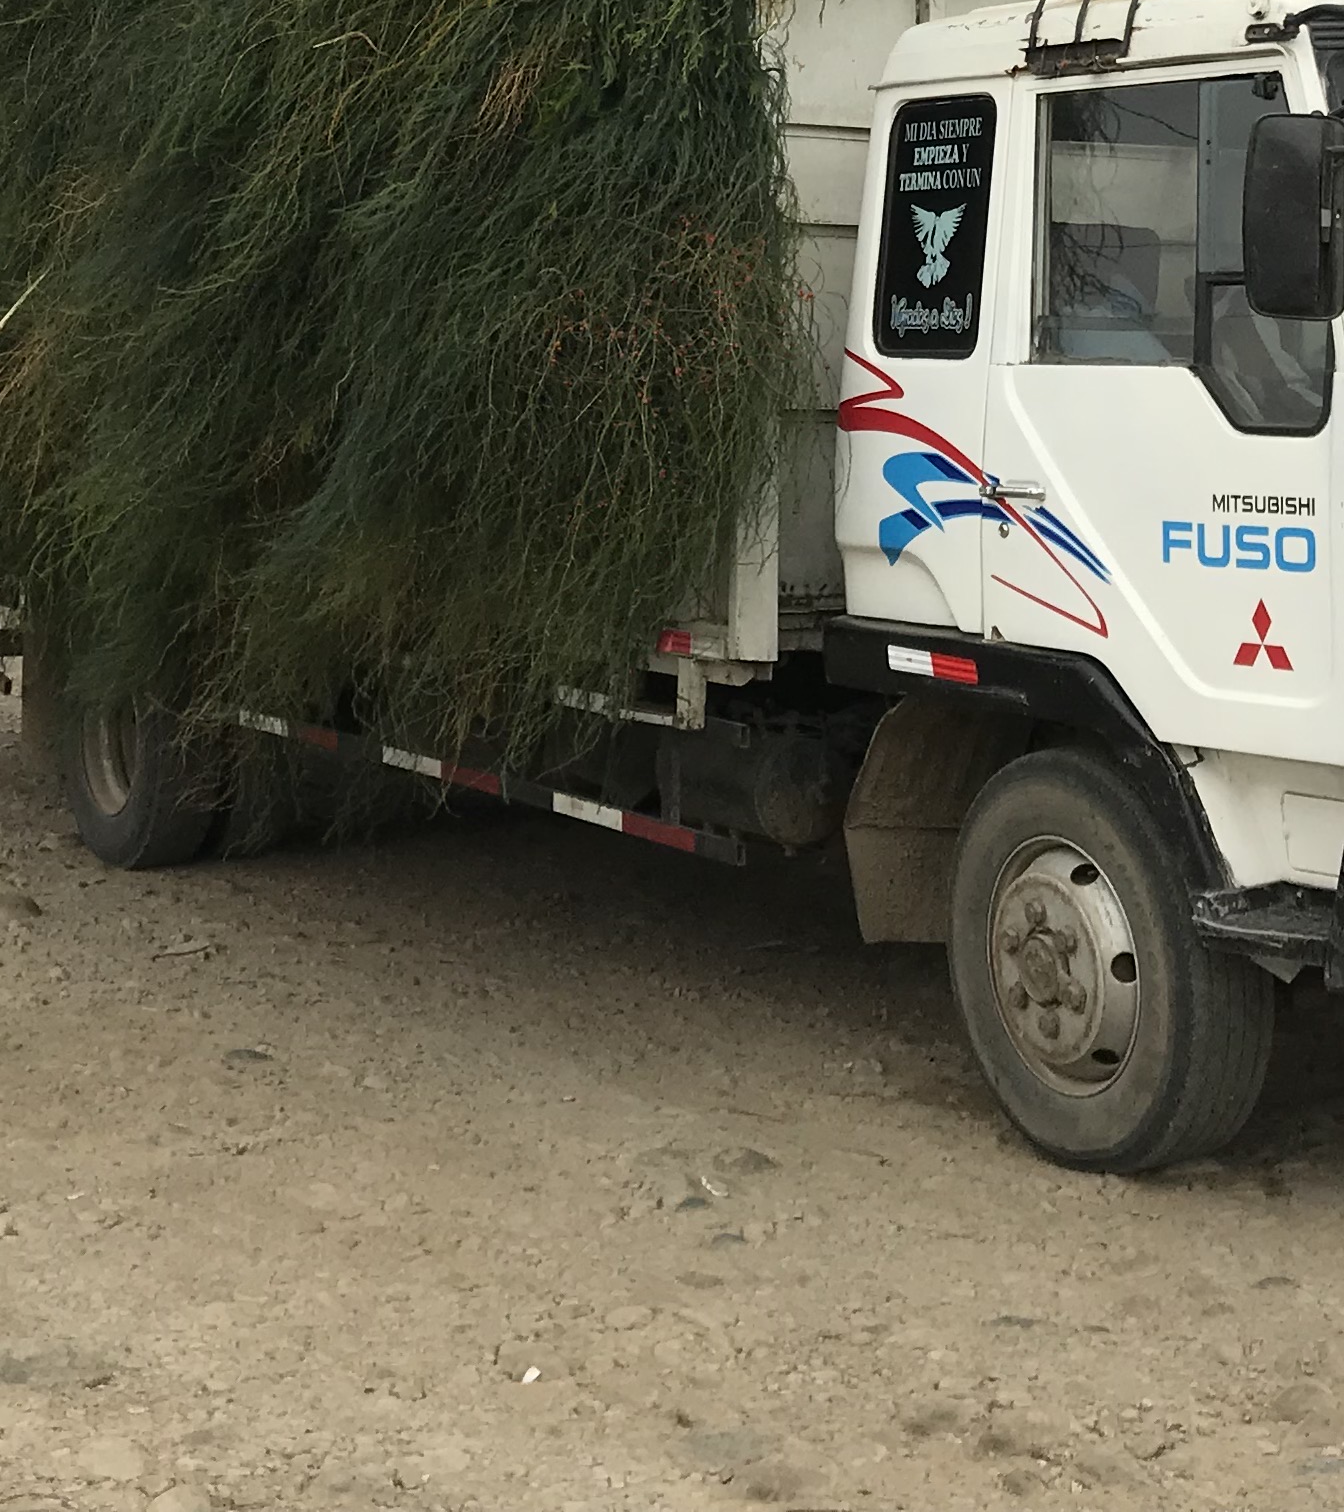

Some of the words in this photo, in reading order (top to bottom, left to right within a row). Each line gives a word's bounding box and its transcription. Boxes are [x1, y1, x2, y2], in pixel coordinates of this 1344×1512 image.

[904, 122, 918, 142] MI
[919, 120, 937, 141] DIA
[939, 116, 983, 140] SIEMPRE
[913, 144, 959, 166] EMPIEZA
[962, 143, 970, 163] Y
[899, 171, 942, 192] TERMINA
[943, 169, 965, 189] CON
[966, 168, 982, 187] UN
[1212, 493, 1316, 517] MITSUBISHI
[1162, 520, 1316, 573] FUSO
